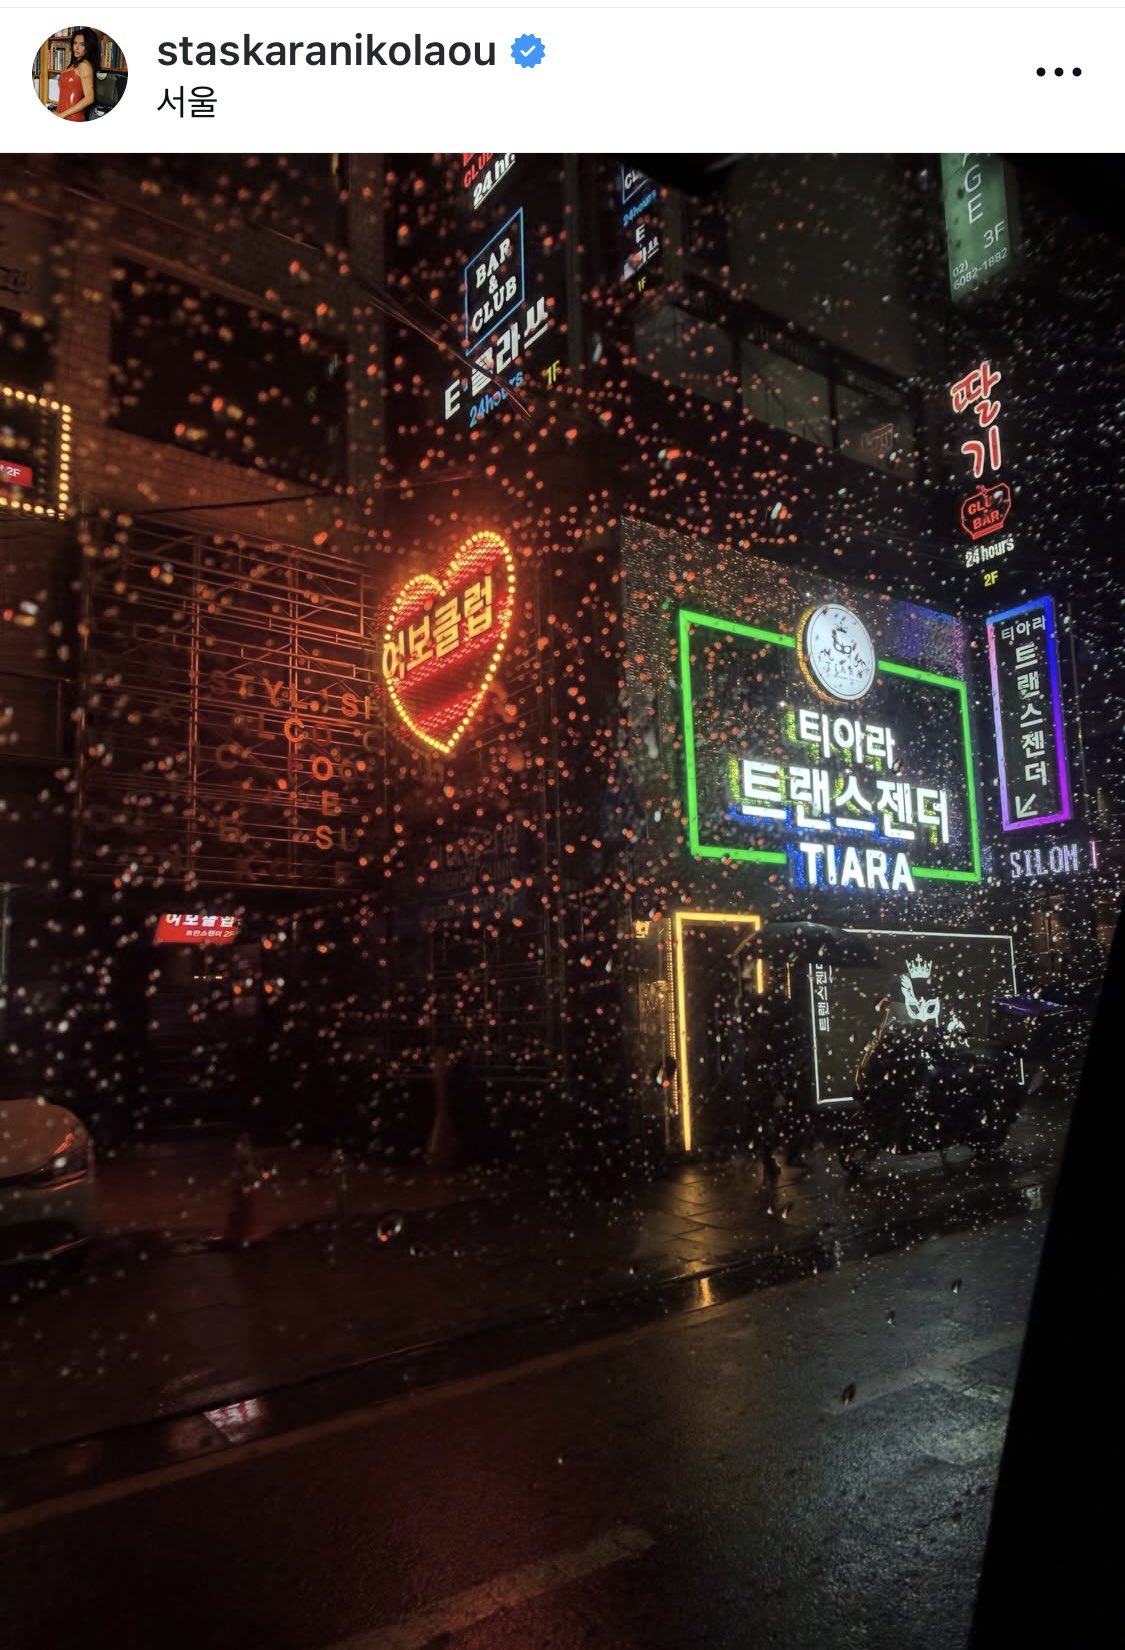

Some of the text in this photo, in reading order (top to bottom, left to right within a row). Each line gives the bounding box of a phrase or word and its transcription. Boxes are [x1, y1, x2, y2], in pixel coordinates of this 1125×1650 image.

[984, 220, 1006, 248] 3F
[475, 238, 512, 288] BAR
[952, 259, 969, 278] 02)
[953, 247, 1008, 290] 6082-1882
[488, 274, 499, 295] &
[472, 276, 517, 333] CLUB
[546, 360, 560, 385] 1F
[950, 361, 1001, 478] 딸기
[968, 492, 1004, 515] CLU
[973, 509, 1000, 530] BAR
[984, 571, 999, 587] 2F
[1001, 615, 1047, 641] 티아라
[1014, 643, 1048, 786] 트랜스젠더
[799, 708, 896, 770] 티아라
[742, 759, 950, 844] 트랜스젠더
[800, 842, 916, 892] TIARA
[1010, 843, 1079, 878] SILOM
